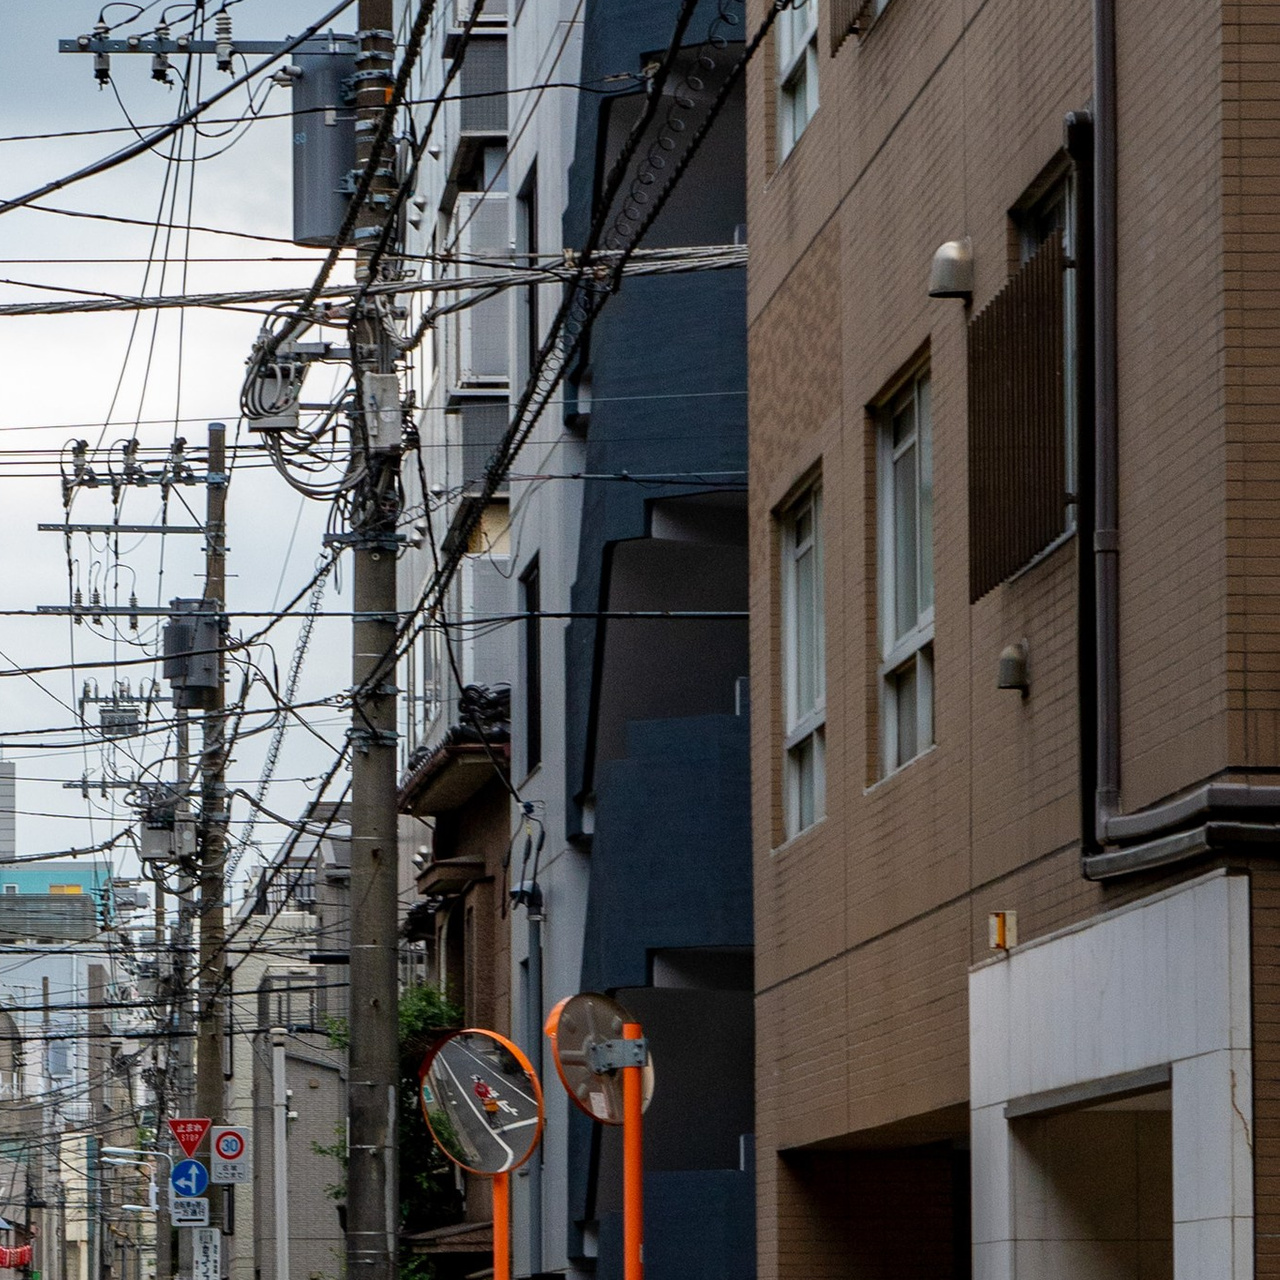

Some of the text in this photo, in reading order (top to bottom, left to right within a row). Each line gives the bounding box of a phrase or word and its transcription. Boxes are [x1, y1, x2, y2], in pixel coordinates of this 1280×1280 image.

[176, 1123, 203, 1133] 止まれ
[180, 1133, 200, 1142] STOP
[221, 1138, 239, 1153] 30
